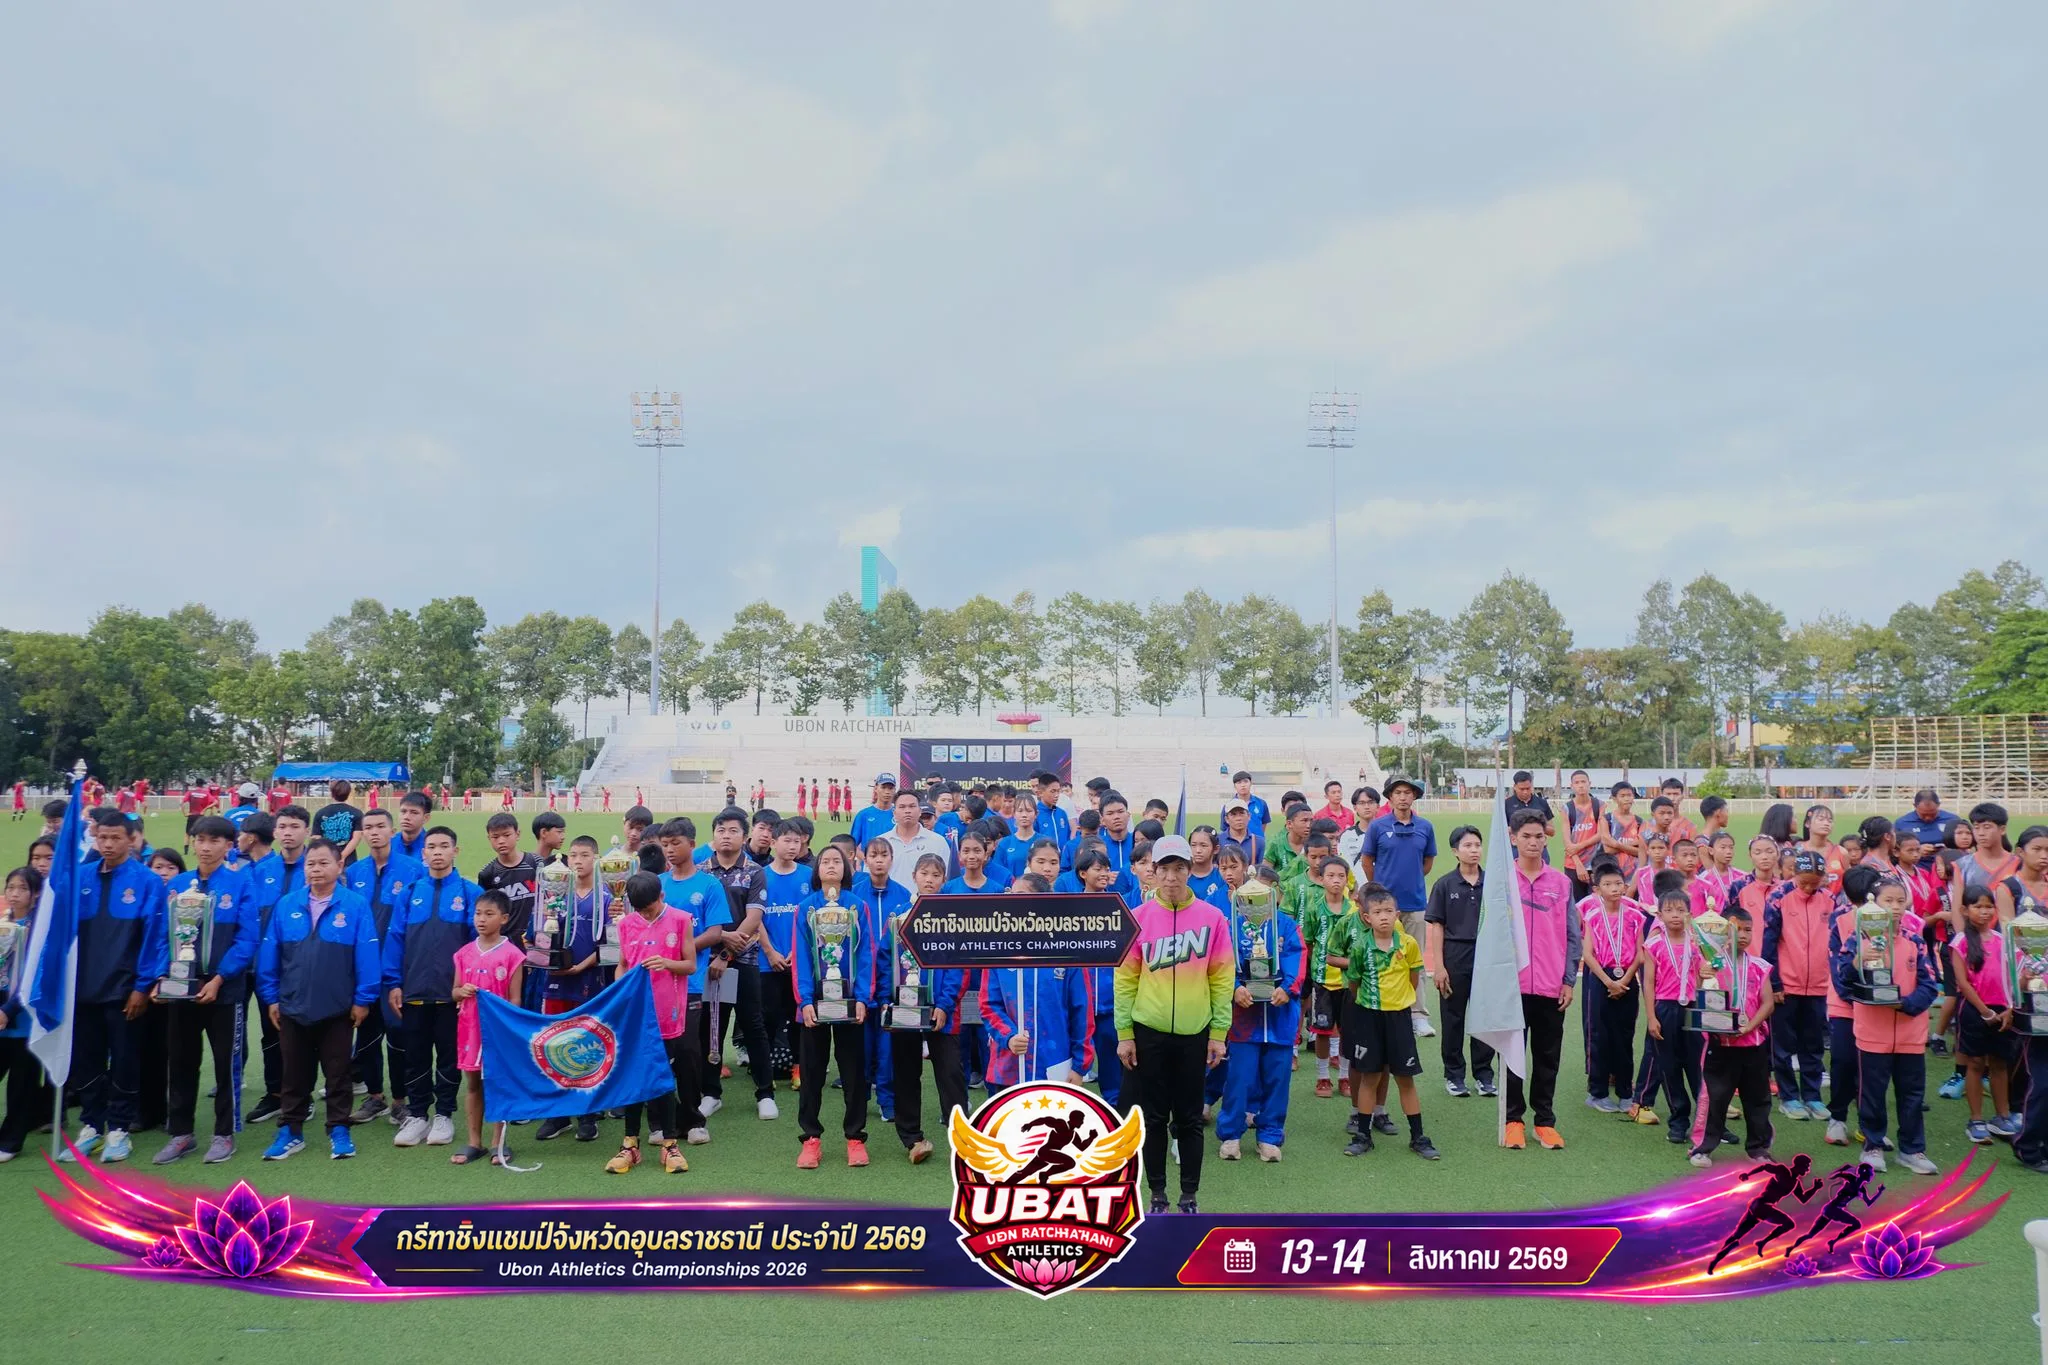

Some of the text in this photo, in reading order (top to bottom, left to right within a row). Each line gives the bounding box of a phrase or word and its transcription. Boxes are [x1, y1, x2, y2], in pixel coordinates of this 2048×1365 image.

[785, 719, 915, 732] UBON RATCHATHA
[922, 940, 1117, 951] UBON ATHLETICS CHAMPIONSHIPS
[1142, 926, 1211, 972] UBN
[1355, 1044, 1368, 1060] 17
